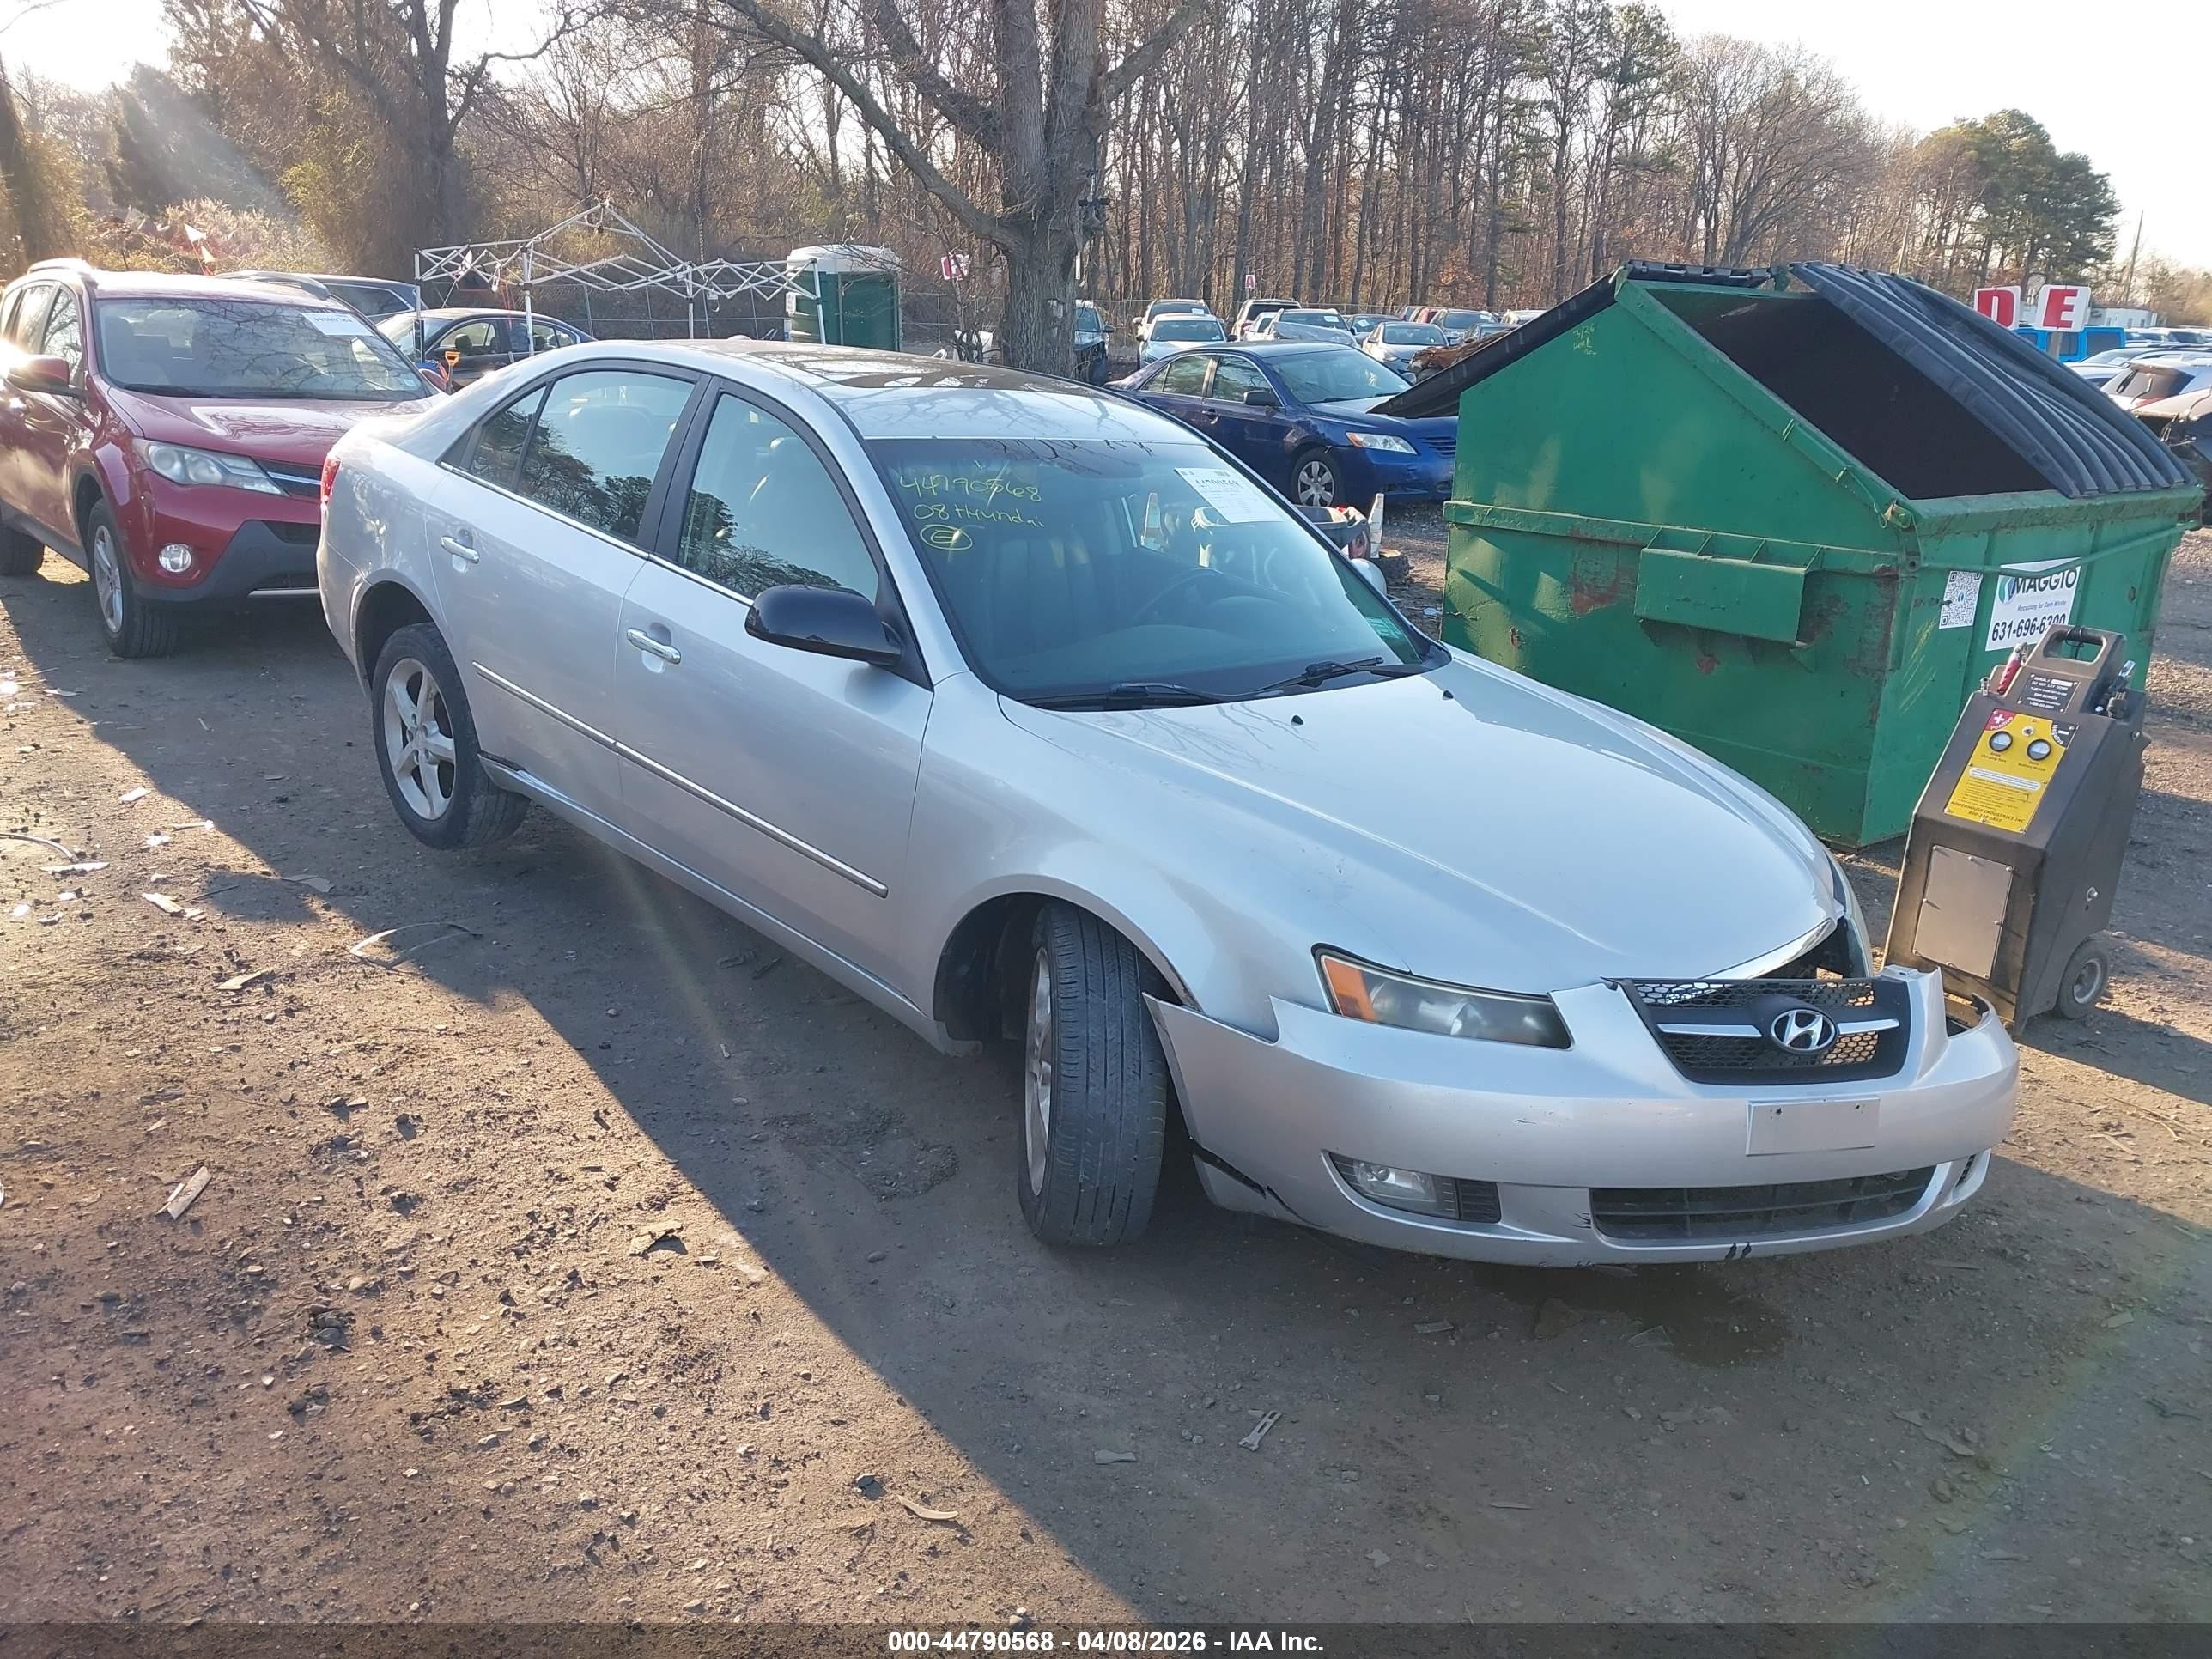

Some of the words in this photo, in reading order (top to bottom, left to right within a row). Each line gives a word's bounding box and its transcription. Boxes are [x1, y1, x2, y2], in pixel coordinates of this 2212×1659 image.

[2042, 288, 2079, 329] E
[914, 503, 950, 520] 08
[2014, 568, 2078, 594] MAGGIO
